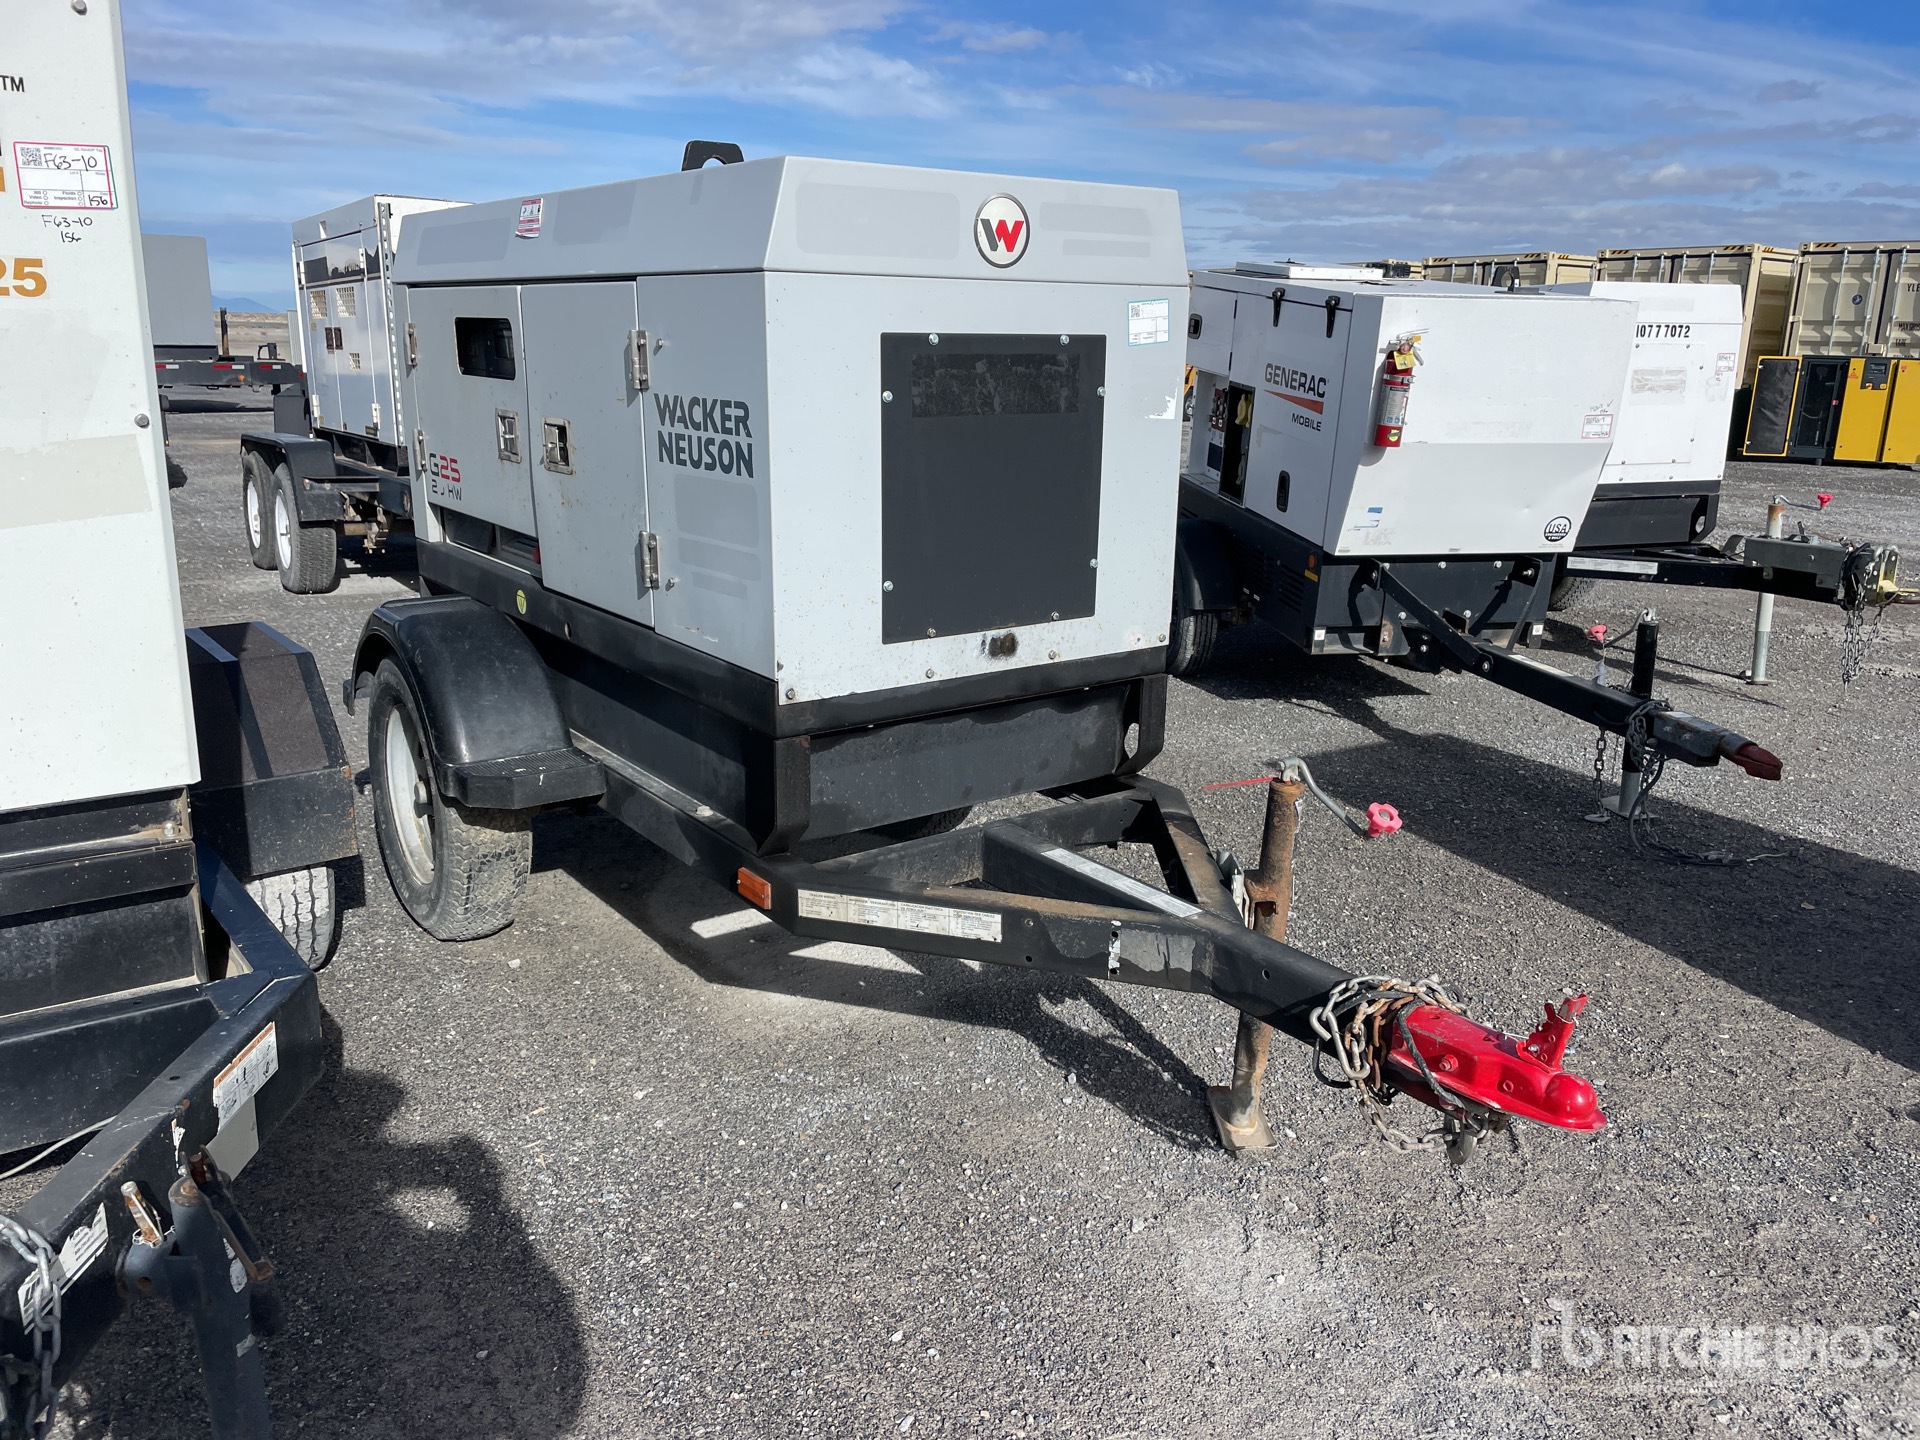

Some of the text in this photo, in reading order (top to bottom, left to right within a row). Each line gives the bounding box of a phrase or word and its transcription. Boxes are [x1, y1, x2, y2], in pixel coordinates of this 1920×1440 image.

[43, 153, 97, 171] F63-10
[41, 214, 93, 228] F63-10
[1264, 362, 1327, 399] GENERAC
[653, 392, 753, 439] WACKER
[1291, 412, 1322, 432] MOBILE
[657, 430, 754, 479] NEUSON
[428, 452, 461, 483] G25
[1548, 523, 1568, 534] USA
